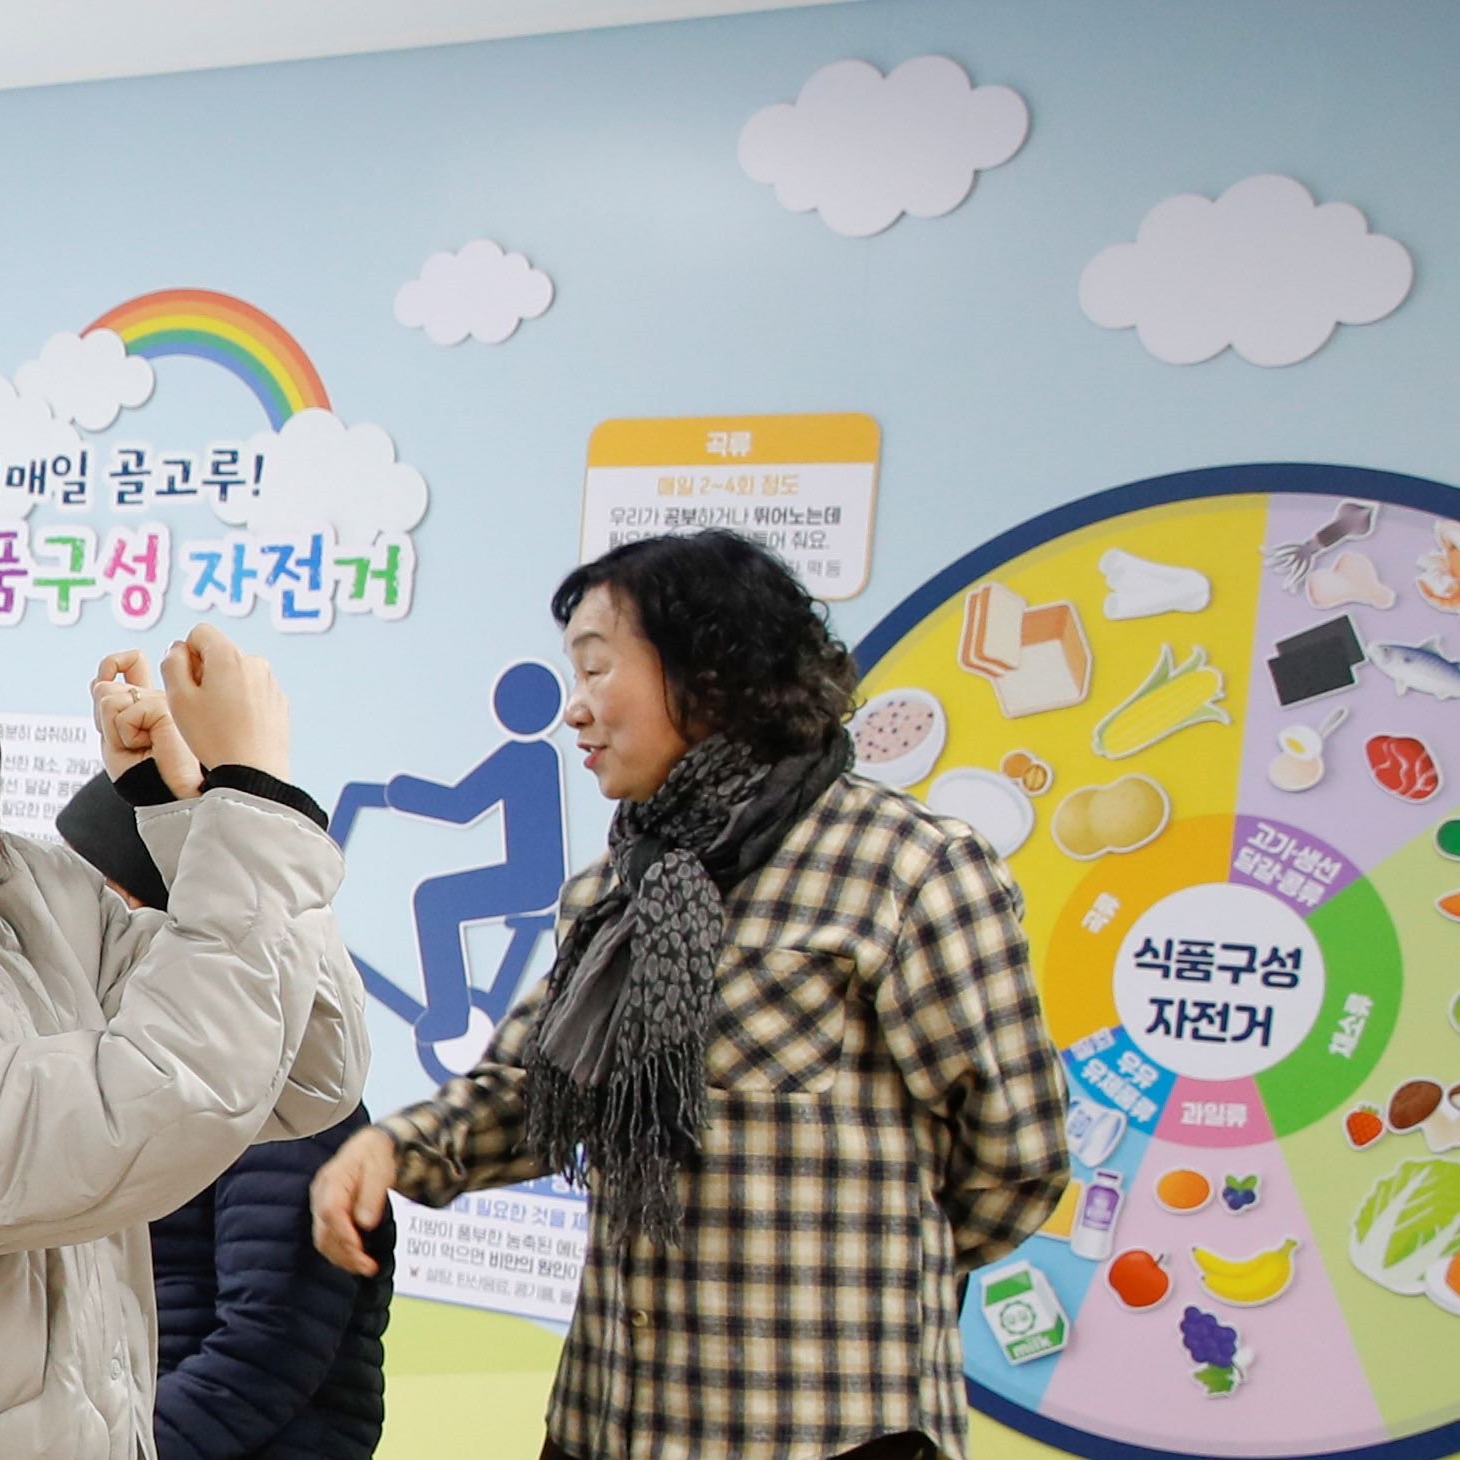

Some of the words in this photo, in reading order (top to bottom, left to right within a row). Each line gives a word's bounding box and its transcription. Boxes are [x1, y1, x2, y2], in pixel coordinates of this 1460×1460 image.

[705, 431, 753, 457] 곡류
[109, 448, 265, 505] 골고루!
[761, 474, 800, 496] 정도
[609, 508, 660, 526] 우리가
[663, 505, 749, 527] 공부하거나
[753, 505, 842, 526] 뛰어노는데
[188, 533, 400, 619] 자전거
[35, 726, 87, 744] 섭취하자
[1134, 936, 1305, 989] 식품구성
[1145, 996, 1275, 1048] 자전거
[1181, 1101, 1248, 1128] 과일류
[488, 1251, 534, 1275] 비만의
